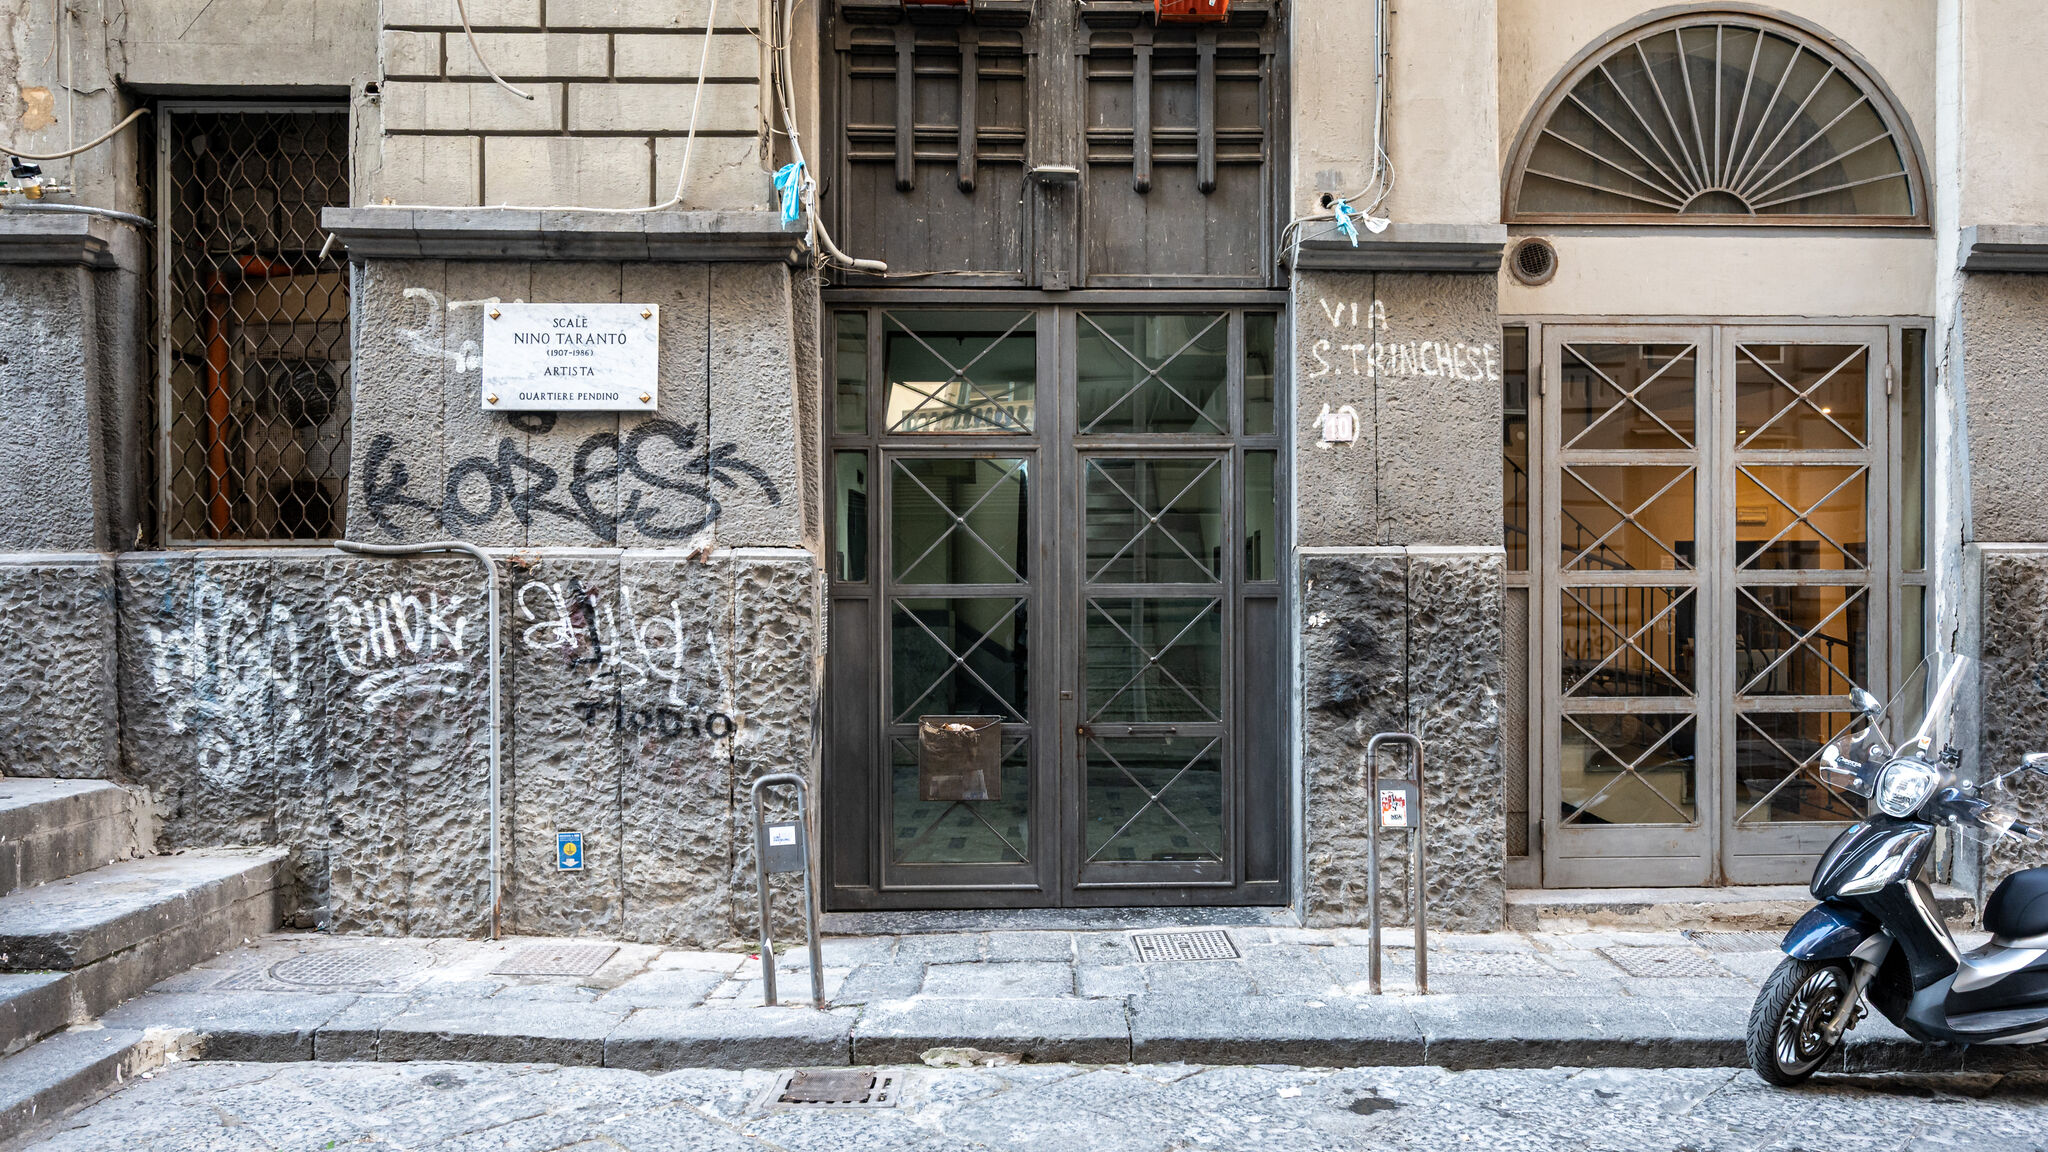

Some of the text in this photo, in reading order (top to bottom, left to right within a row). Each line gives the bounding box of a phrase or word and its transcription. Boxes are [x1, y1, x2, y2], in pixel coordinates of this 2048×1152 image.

[1319, 298, 1389, 330] VIA
[552, 317, 588, 329] SCALE
[514, 332, 627, 345] NINO TARANTO
[546, 349, 594, 357] (1907-1986)
[543, 366, 595, 377] ARTISTA
[519, 392, 619, 401] QUARTIERE PENDINO
